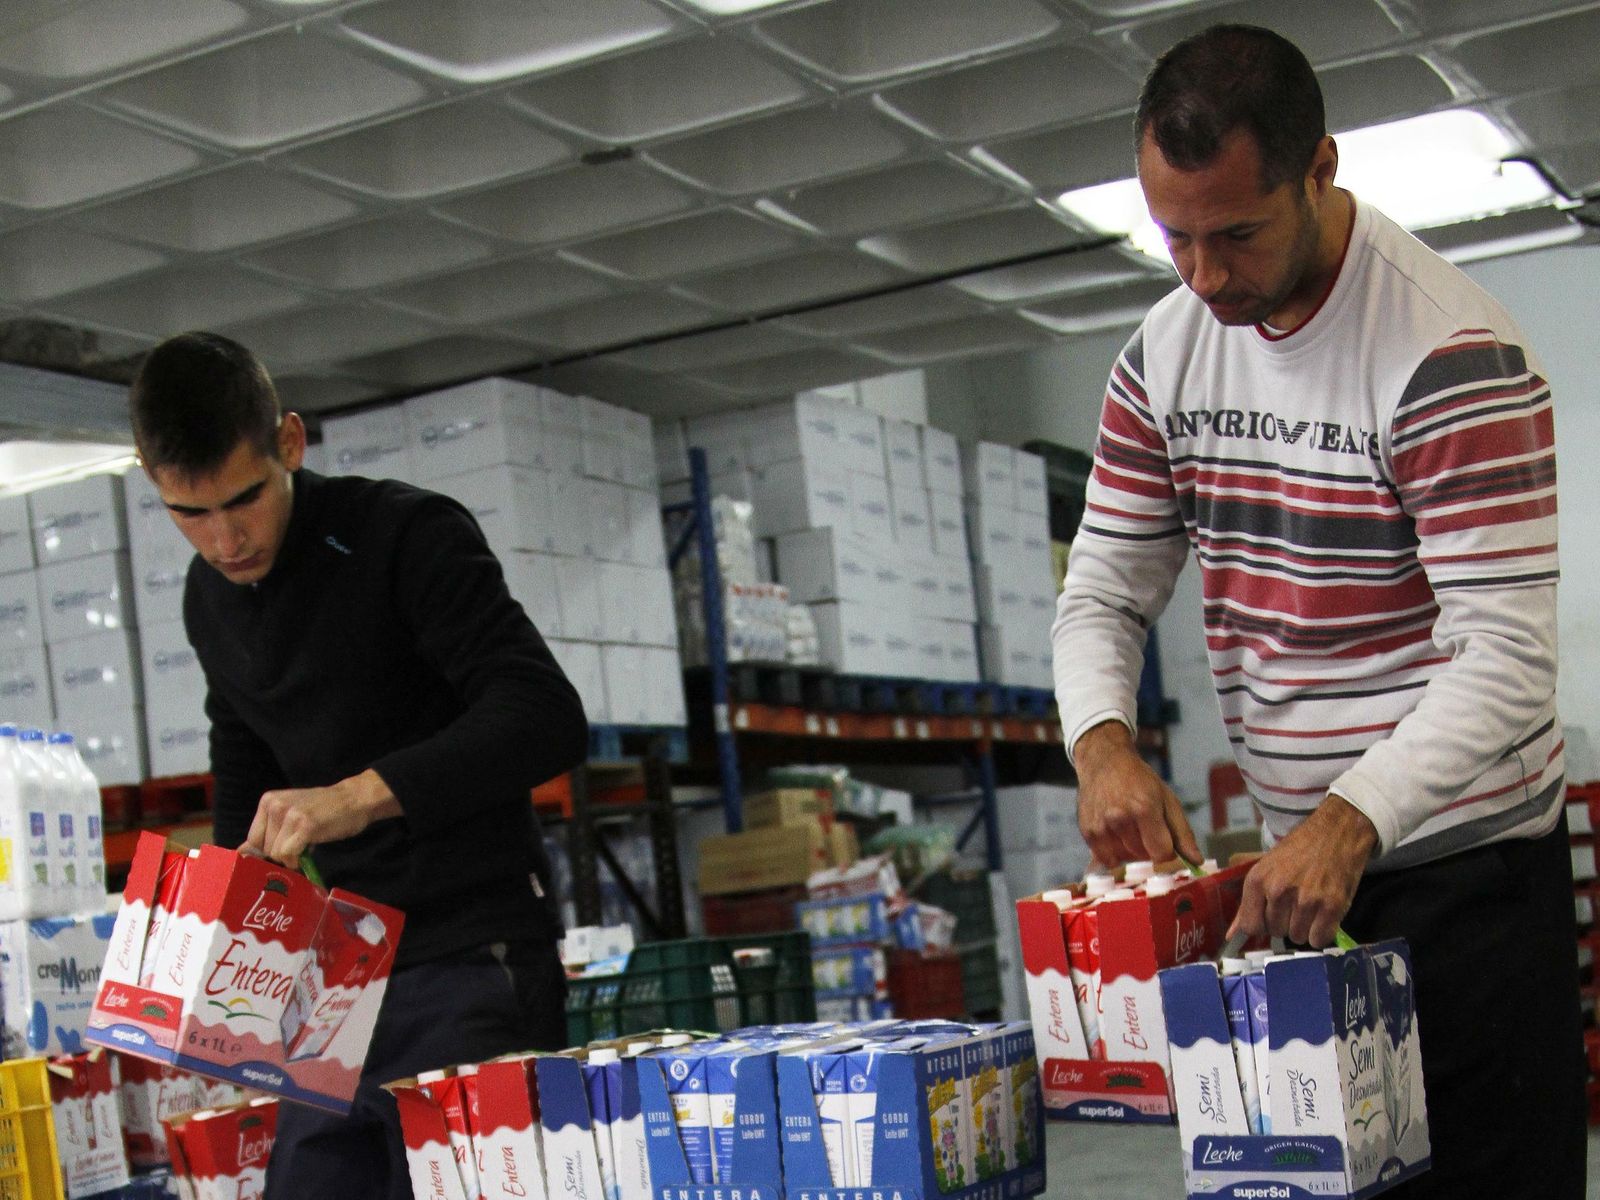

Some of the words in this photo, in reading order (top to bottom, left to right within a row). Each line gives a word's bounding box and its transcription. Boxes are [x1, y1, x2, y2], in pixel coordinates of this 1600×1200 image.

[243, 890, 293, 932] Leche
[117, 918, 136, 971] Entera
[1175, 919, 1205, 962] Leche
[38, 956, 101, 994] creMont
[169, 932, 193, 987] Entera
[205, 939, 294, 1003] Entera
[104, 987, 129, 1007] Leche
[1345, 983, 1367, 1029] Leche
[1048, 989, 1070, 1044] Entera
[1123, 995, 1148, 1051] Entera
[112, 1029, 146, 1045] superSol
[189, 1031, 197, 1044] 6
[213, 1038, 226, 1053] 1L
[242, 1067, 283, 1085] superSol
[1052, 1064, 1084, 1084] Leche
[1349, 1037, 1375, 1080] Semi
[1079, 1106, 1124, 1118] superSol
[1196, 1073, 1216, 1121] Semi
[1298, 1073, 1320, 1121] Semi
[648, 1112, 670, 1123] ENTERA
[785, 1116, 812, 1127] ENTERA
[882, 1112, 909, 1124] GORDO
[238, 1132, 276, 1167] Lech
[1203, 1141, 1244, 1164] Leche
[1264, 1142, 1292, 1153] ORIGEN
[1294, 1141, 1324, 1154] GALICIA
[501, 1145, 526, 1197] Entera
[562, 1155, 578, 1196] Semi
[1308, 1181, 1314, 1191] 6
[1321, 1181, 1330, 1191] 1L
[663, 1189, 761, 1200] ENTERA
[1233, 1187, 1290, 1199] superSol
